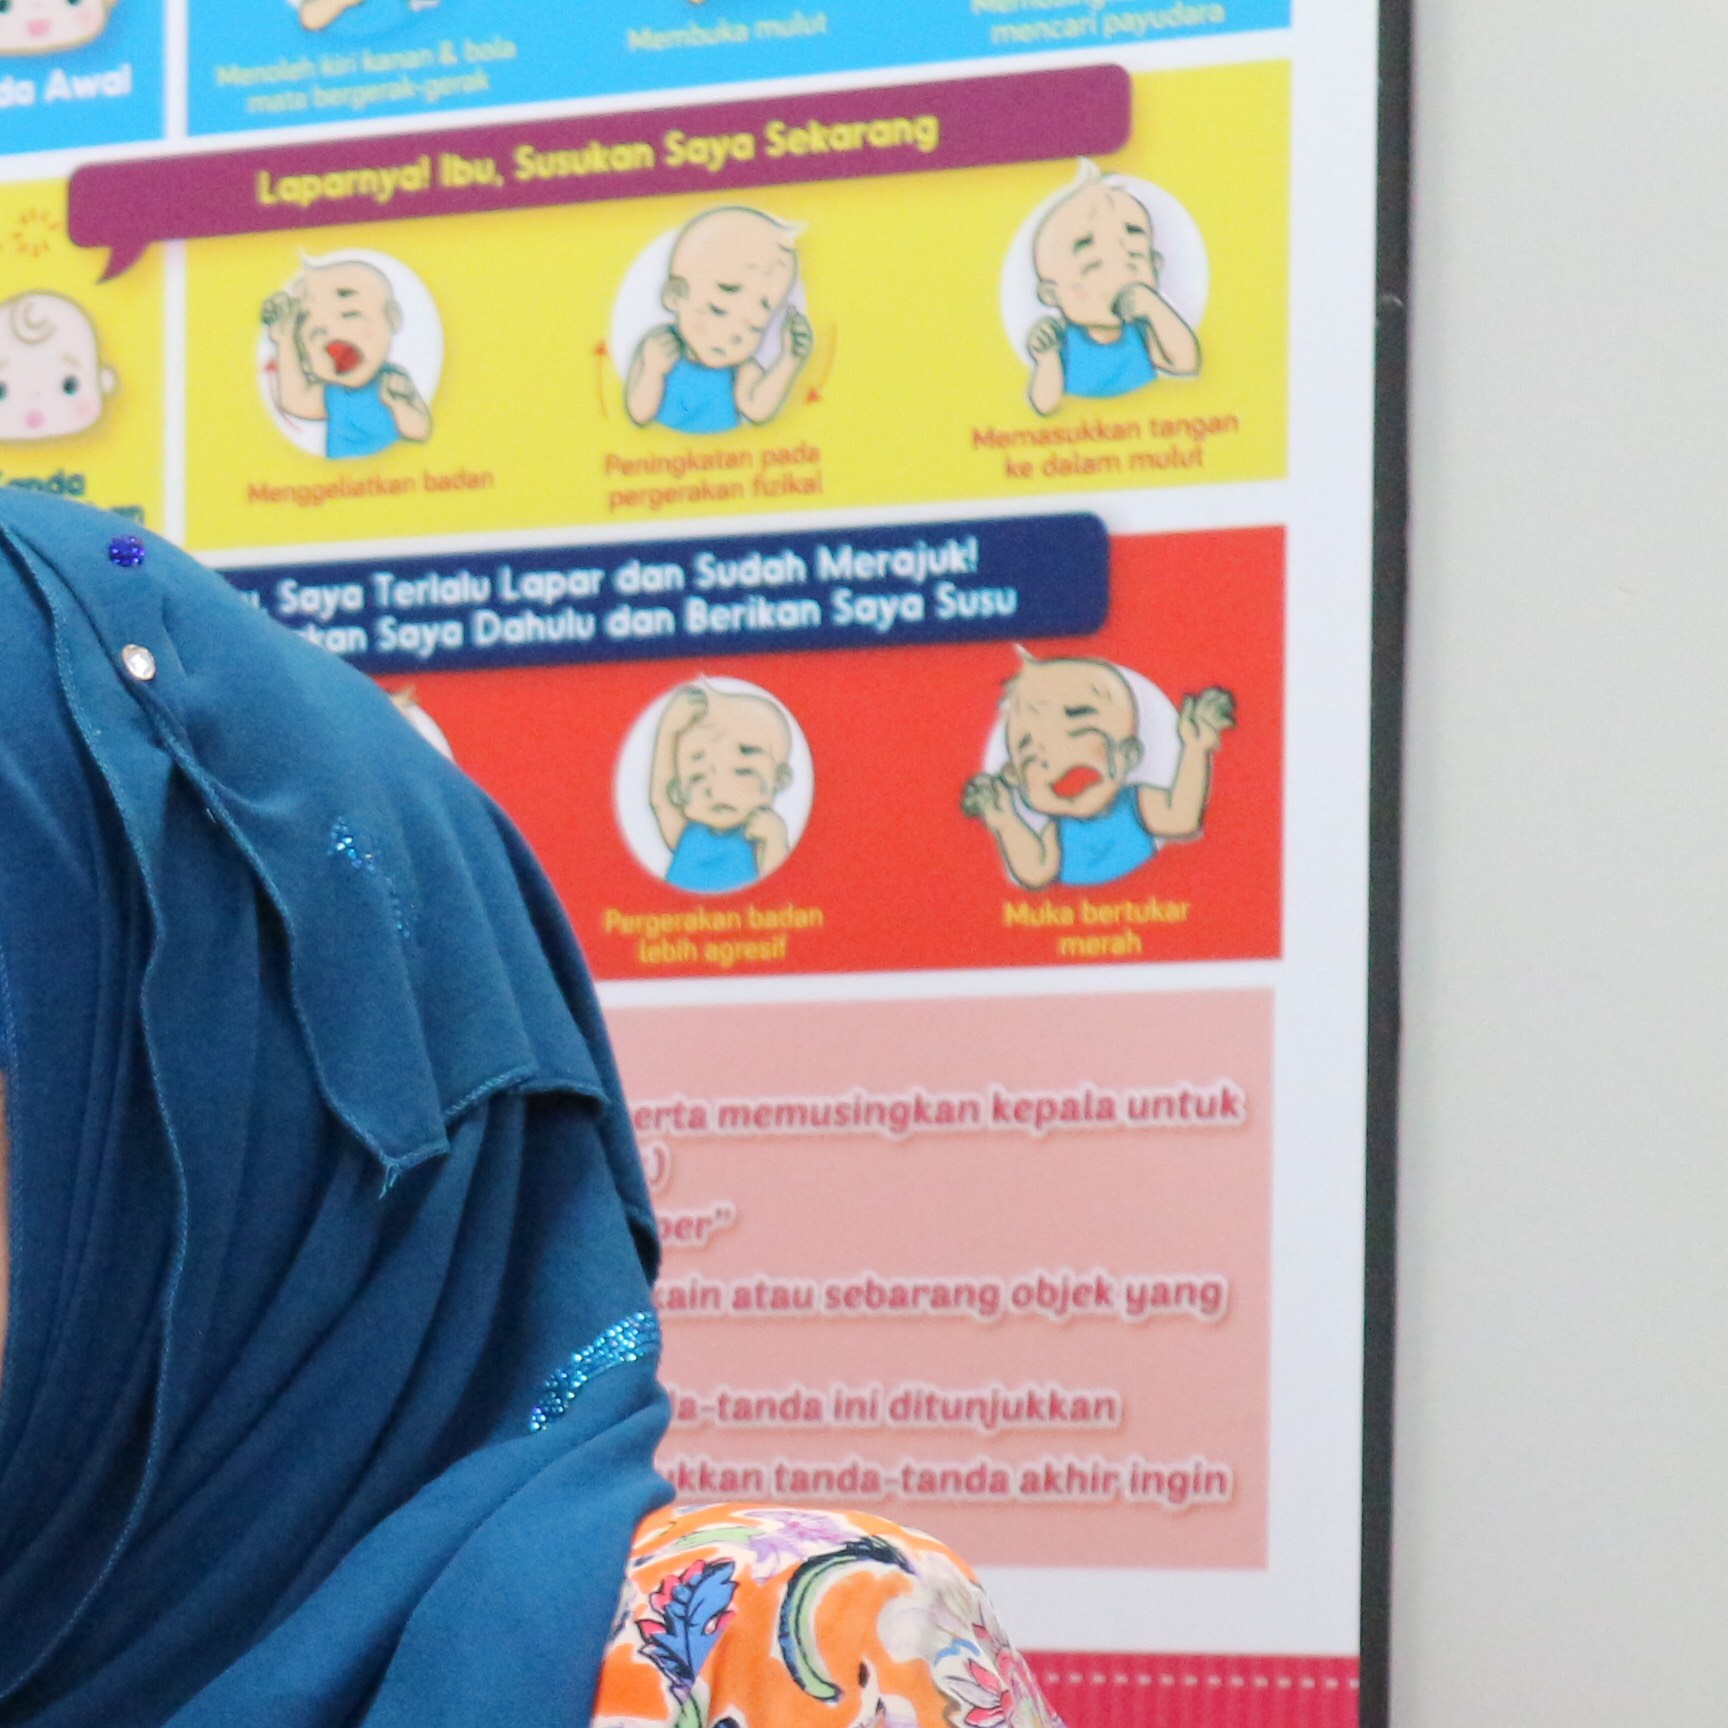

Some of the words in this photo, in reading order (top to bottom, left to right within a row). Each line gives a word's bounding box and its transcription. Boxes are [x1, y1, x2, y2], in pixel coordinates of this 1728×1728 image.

[46, 63, 133, 101] Awal
[257, 153, 431, 206] Laparnya!
[440, 150, 503, 189] Ibu,
[514, 139, 655, 178] Susukan
[664, 128, 755, 172] Saya
[764, 113, 940, 156] Sekarang
[972, 419, 1143, 451] Memasukkan
[1149, 411, 1240, 444] tangan
[758, 443, 822, 473] pada
[1004, 452, 1037, 479] ke
[1042, 449, 1121, 478] dalam
[1126, 442, 1205, 472] mulut
[424, 466, 496, 493] badan
[276, 577, 365, 622] Saya
[371, 570, 492, 609] Terlalu
[501, 562, 604, 605] Lapar
[614, 553, 683, 592] dan
[696, 547, 806, 588] Sudah
[817, 536, 979, 585] Merajuk!
[376, 614, 464, 660] Saya
[472, 600, 594, 646] Dahulu
[605, 594, 675, 636] dan
[684, 588, 821, 632] Berikan
[833, 587, 926, 632] Saya
[936, 583, 1018, 618] Susu
[748, 903, 823, 930] badan
[1003, 900, 1074, 928] Muka
[1058, 930, 1142, 957] merah
[717, 1091, 981, 1134] memusingkan
[991, 1089, 1115, 1130] kepala
[1127, 1086, 1242, 1121] untuk
[732, 1280, 814, 1311] atau
[825, 1275, 999, 1316] sebarang
[1011, 1274, 1111, 1316] objek
[1126, 1278, 1221, 1317] yang
[834, 1392, 879, 1420] ini
[890, 1390, 1116, 1429] ditunjukkan
[775, 1461, 1006, 1493] tanda-tanda
[1019, 1461, 1118, 1496] akhir
[1129, 1461, 1228, 1502] ingin
